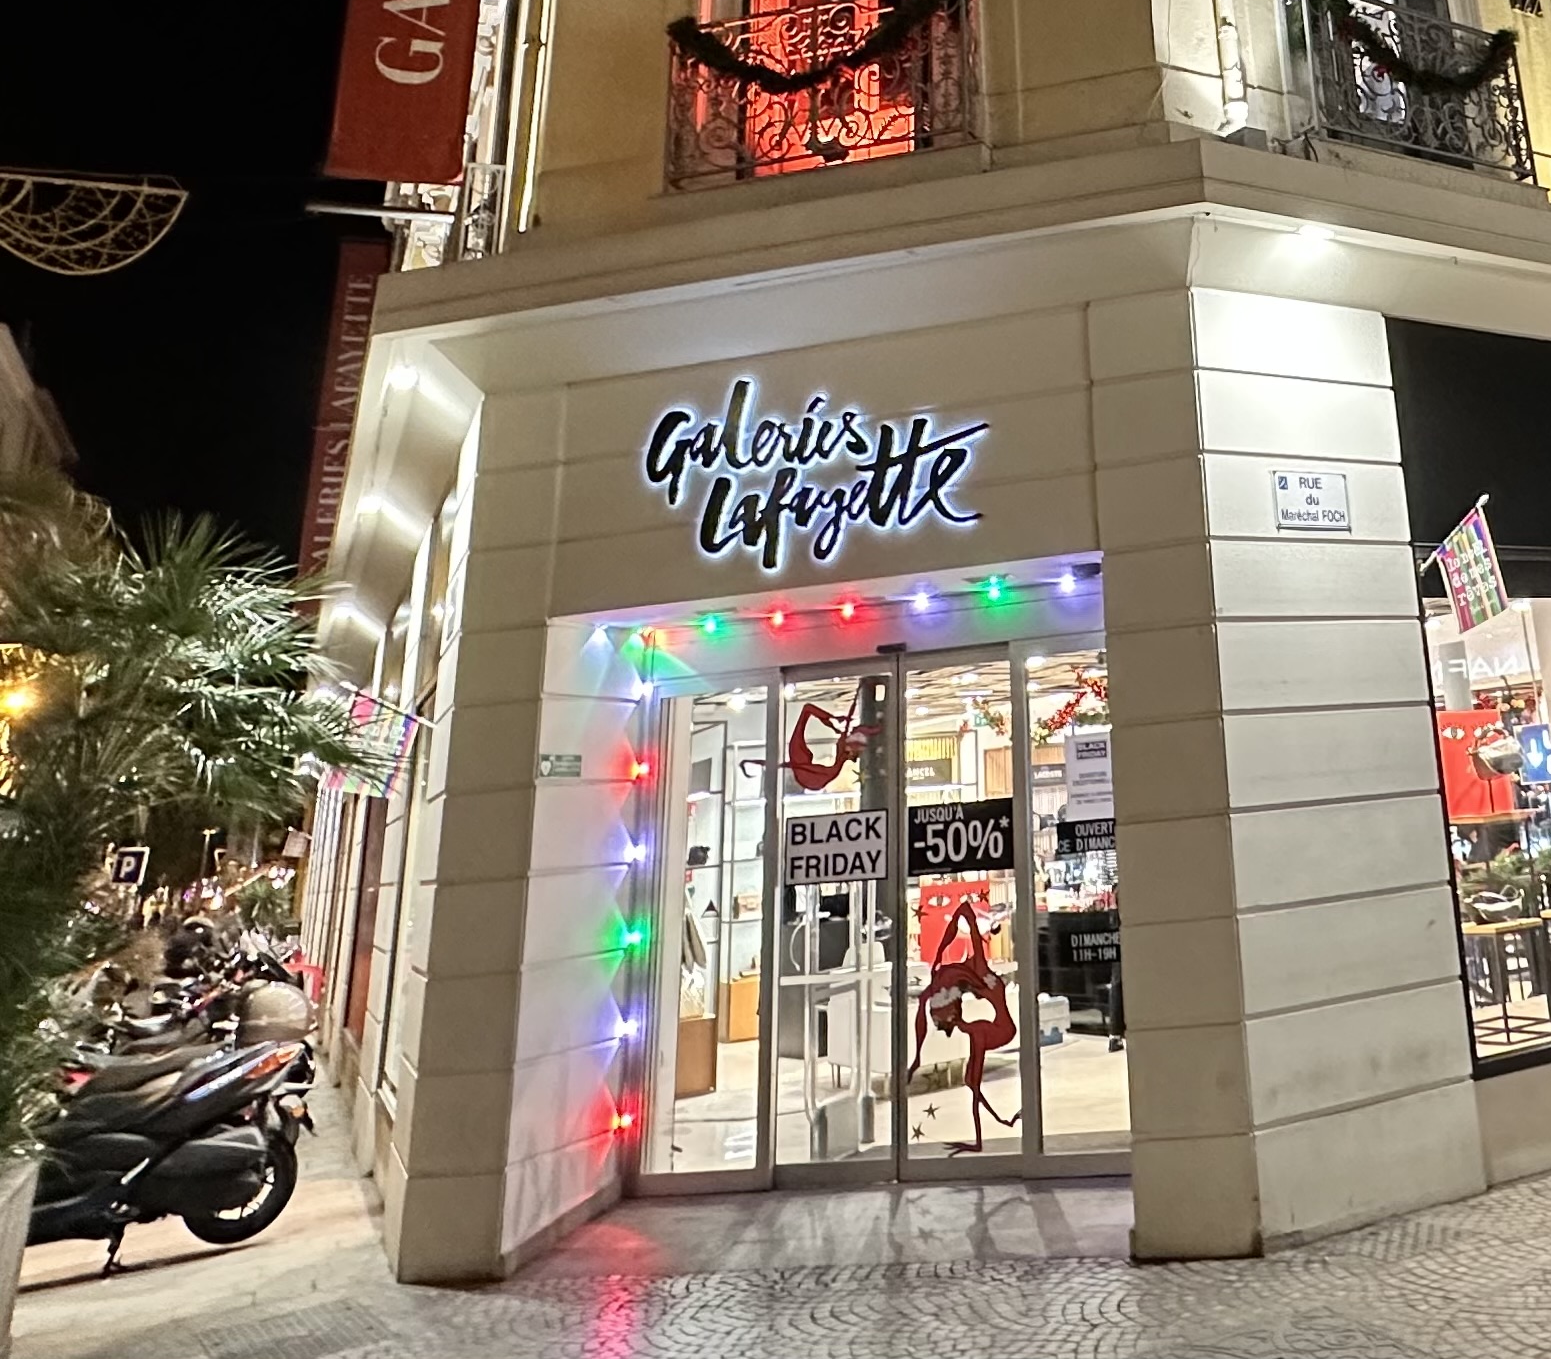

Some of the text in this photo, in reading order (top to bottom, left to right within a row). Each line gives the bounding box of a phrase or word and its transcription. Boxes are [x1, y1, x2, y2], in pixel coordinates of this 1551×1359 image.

[645, 380, 870, 506] Galeries
[1299, 477, 1323, 489] RUE
[700, 415, 989, 569] Lafayette
[1305, 494, 1319, 505] du
[310, 442, 349, 572] ALERIES
[1281, 509, 1345, 522] Maréchal FOCH
[790, 816, 882, 846] BLACK
[1075, 822, 1114, 836] OUVERT
[1076, 836, 1116, 852] DIMANC
[120, 853, 134, 878] P
[789, 850, 882, 880] FRIDAY
[1071, 931, 1120, 947] DIMANCHE
[1072, 947, 1117, 961] 11H-19H
